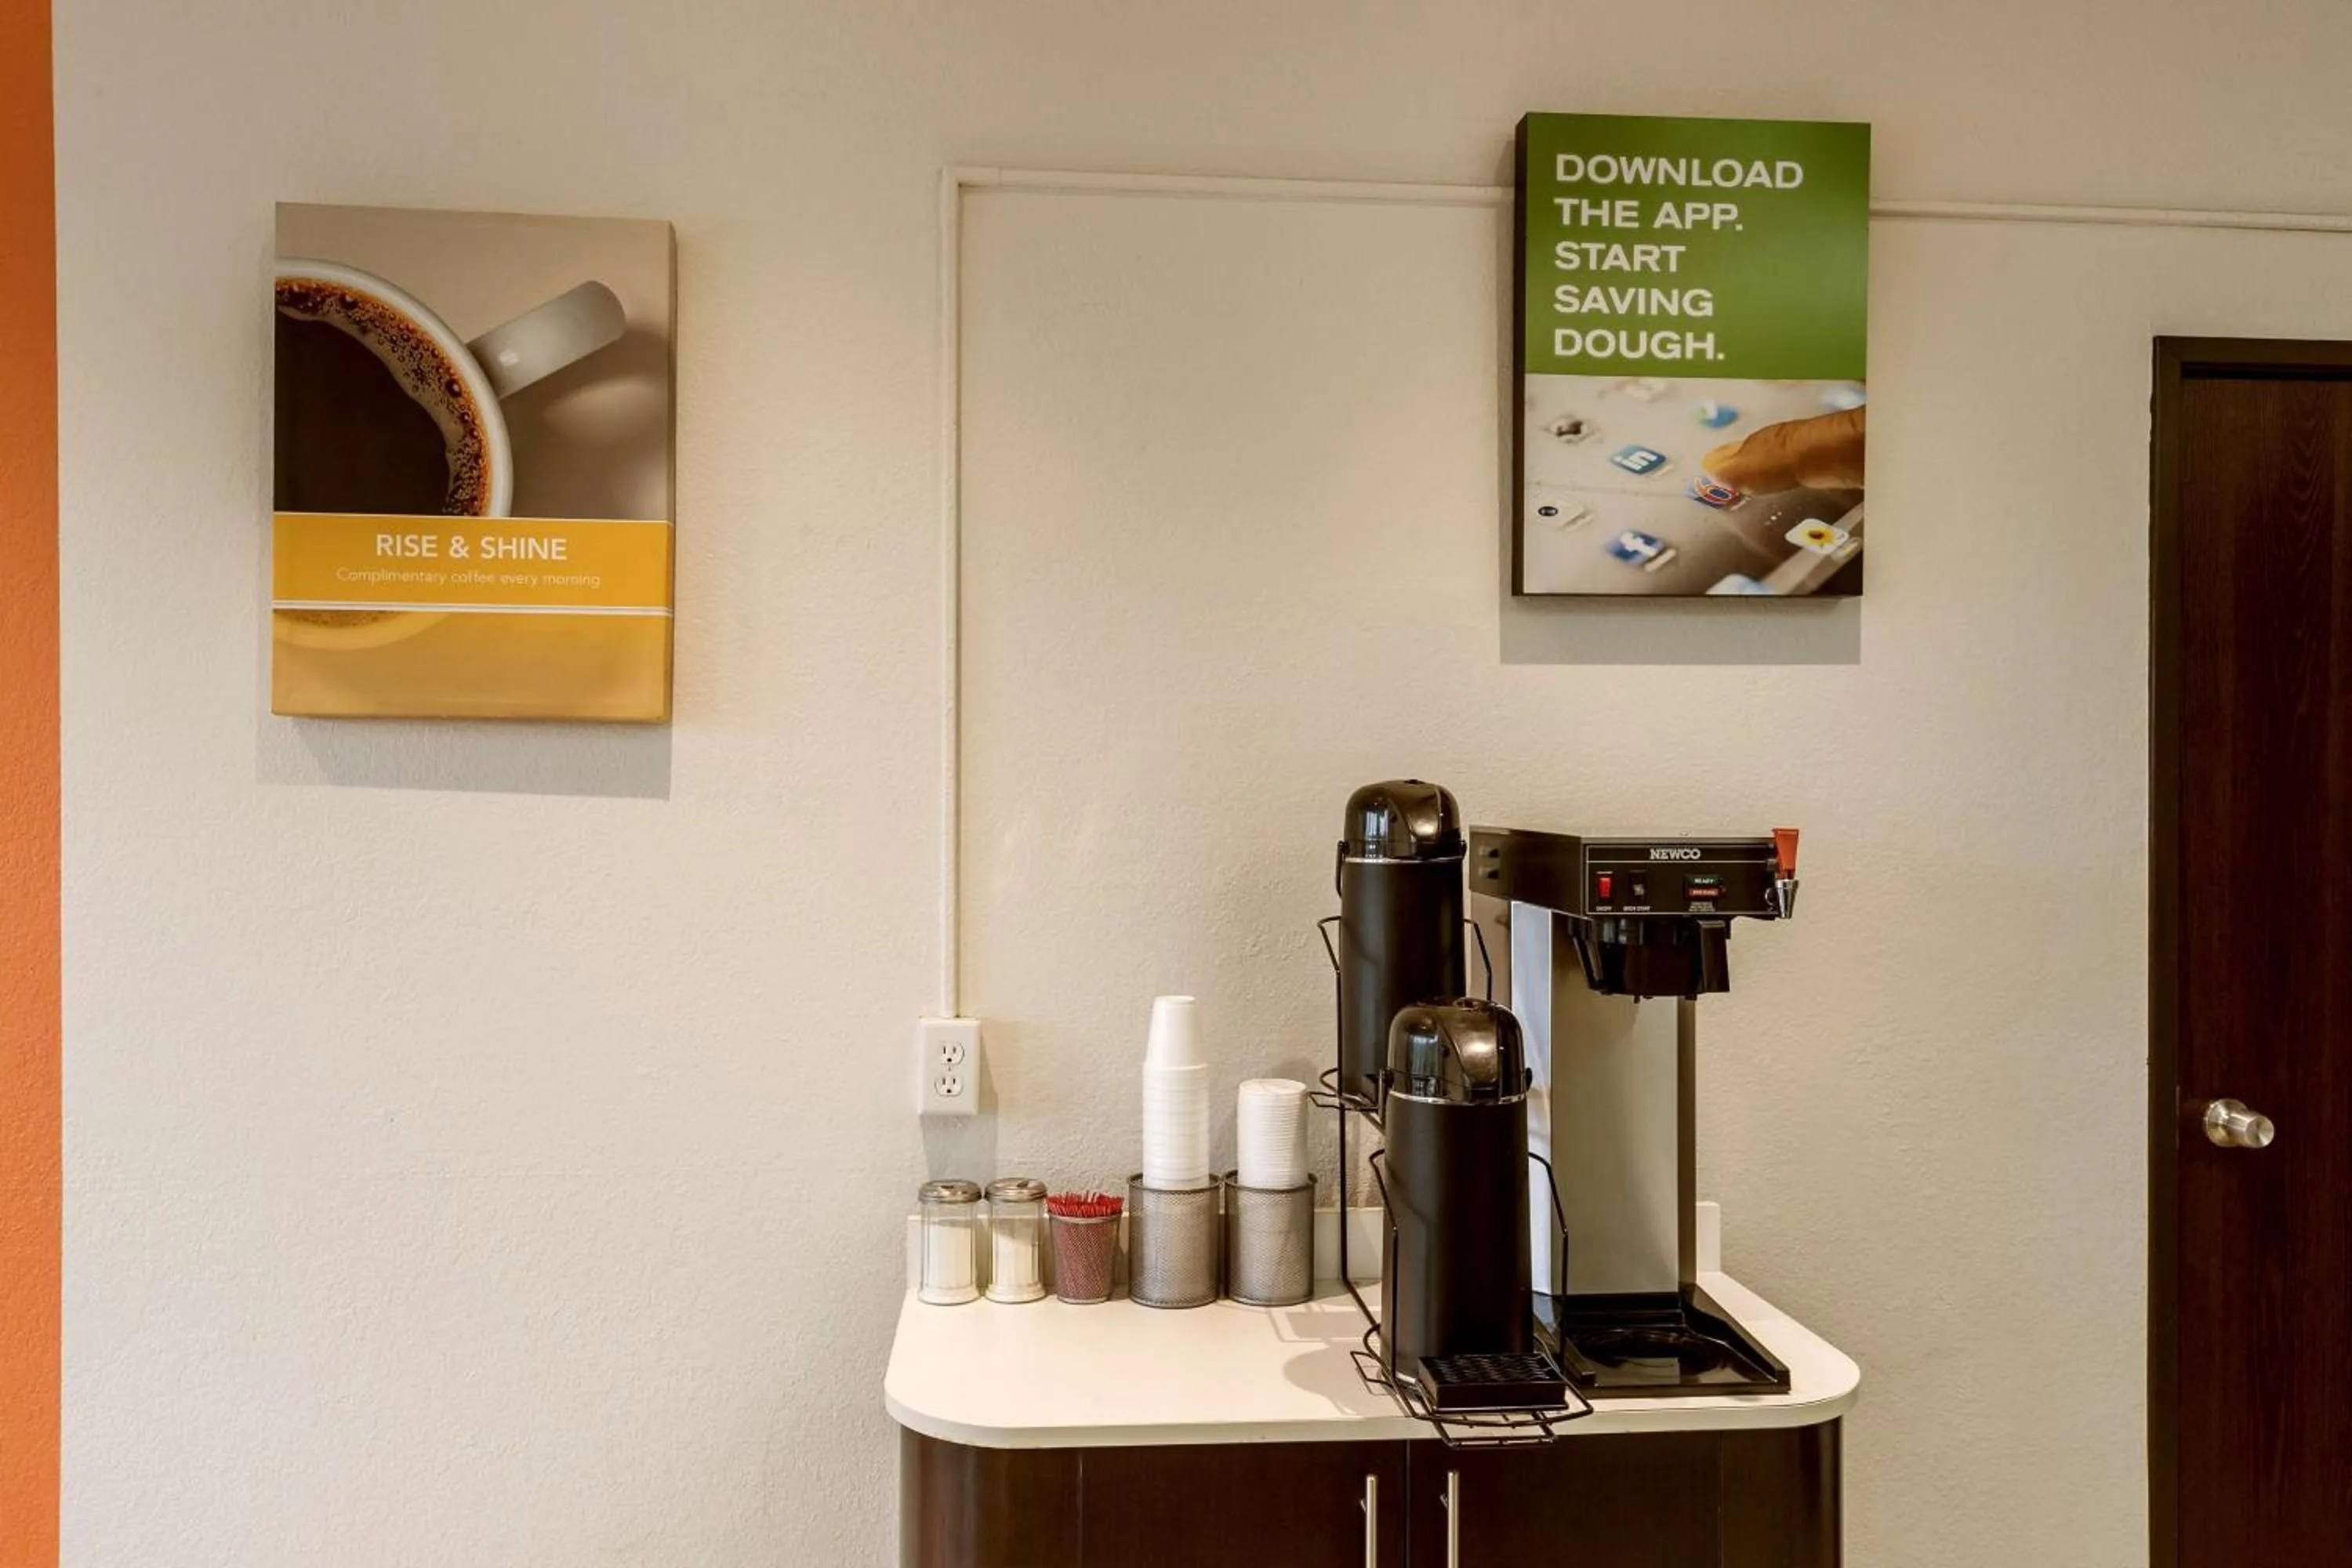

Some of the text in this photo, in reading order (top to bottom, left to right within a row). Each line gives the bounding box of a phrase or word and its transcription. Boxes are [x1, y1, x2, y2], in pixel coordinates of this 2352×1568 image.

[1555, 154, 1803, 189] DOWNLOAD
[1554, 198, 1743, 230] THE APP.
[1555, 241, 1686, 272] START
[1554, 285, 1714, 317] SAVING
[1554, 328, 1725, 360] DOUGH.
[1613, 450, 1658, 471] in
[376, 534, 568, 561] RISE & SHINE
[336, 566, 446, 586] Complimentary
[451, 570, 495, 584] coffee
[500, 573, 538, 587] every
[1650, 848, 1700, 860] NEWCO
